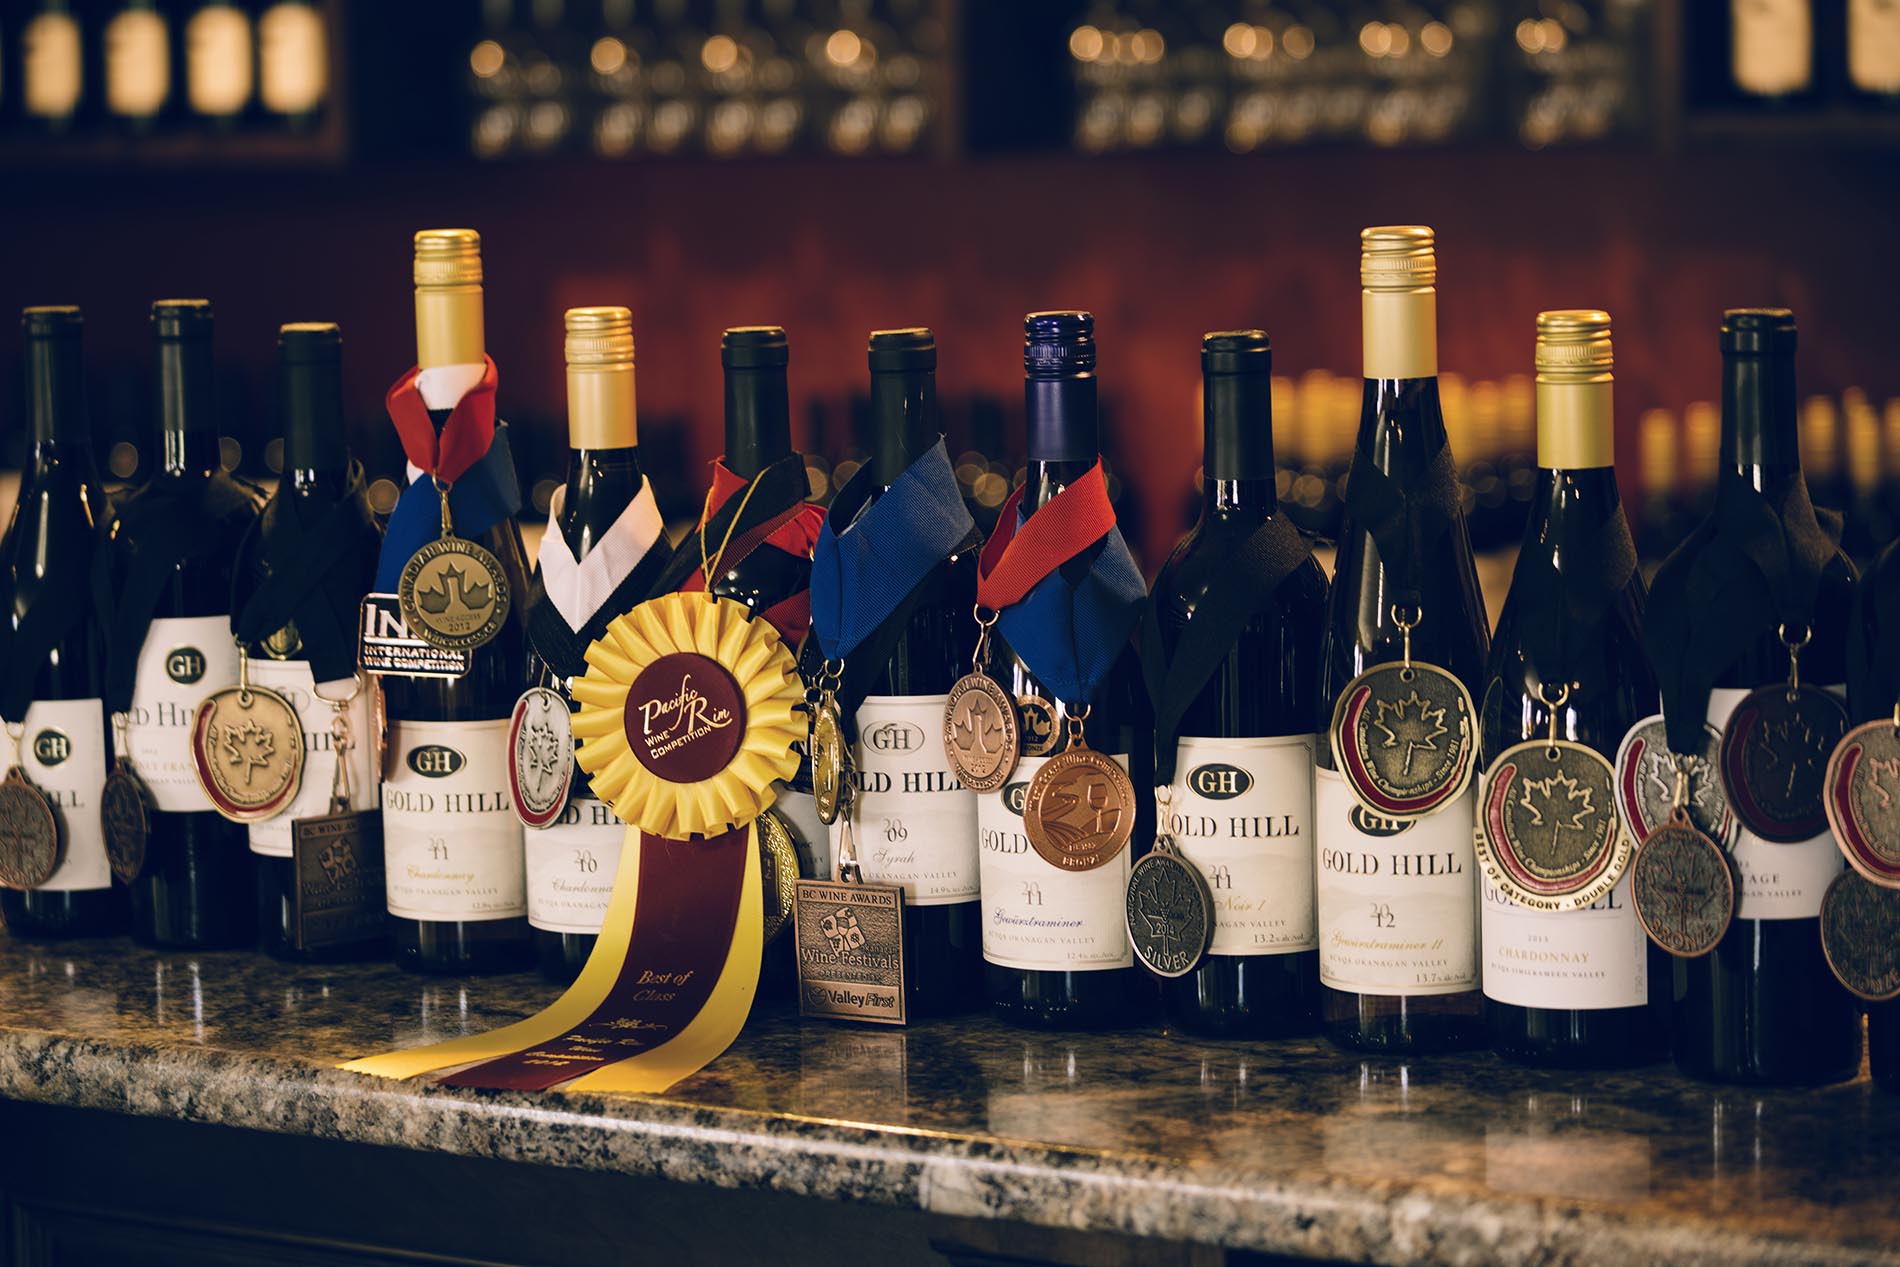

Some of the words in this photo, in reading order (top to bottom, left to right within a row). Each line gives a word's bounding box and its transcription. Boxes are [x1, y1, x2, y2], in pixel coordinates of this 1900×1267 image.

[403, 546, 436, 611] CANADIAN
[437, 542, 473, 554] WINE
[448, 621, 471, 632] 2012
[363, 645, 465, 660] INTERNATIONAL
[168, 655, 201, 677] GH
[363, 656, 392, 667] WINE
[393, 658, 465, 671] COMPETITION
[970, 677, 994, 695] WINE
[638, 673, 699, 736] Pacific
[683, 696, 733, 734] Rim
[36, 737, 68, 759] GH
[650, 725, 712, 760] COMPETITION
[872, 728, 912, 750] GH
[416, 751, 453, 772] GH
[1198, 770, 1239, 793] GH
[386, 788, 434, 813] GOLD
[444, 791, 510, 813] HILL
[1229, 815, 1299, 838] HILL
[981, 828, 1028, 854] GOLD
[872, 850, 916, 868] Syrah
[1137, 860, 1155, 876] WINE
[1322, 848, 1379, 875] GOLD
[1391, 852, 1462, 876] HILL
[1475, 833, 1490, 863] BEST
[1487, 866, 1501, 881] OF
[1500, 883, 1560, 910] CATEGORY
[1574, 873, 1616, 907] DOUBLE
[1614, 838, 1631, 871] GOLD
[803, 890, 816, 899] BC
[819, 891, 847, 902] WINE
[850, 893, 892, 905] AWARDS
[1156, 922, 1175, 935] 2014
[1250, 919, 1287, 928] VALLEY
[1060, 935, 1096, 945] VALLEY
[801, 948, 837, 964] Wine
[841, 951, 899, 969] Festivals
[1144, 945, 1190, 970] SILVER
[1354, 958, 1408, 968] OKANAGAN
[1412, 959, 1448, 968] VALLEY
[1498, 946, 1591, 964] CHARDONNAY
[636, 970, 673, 986] Best
[672, 970, 694, 986] of
[1572, 970, 1607, 979] VALLEY
[633, 989, 677, 1003] Class
[827, 990, 865, 1008] Valley
[865, 993, 896, 1009] First
